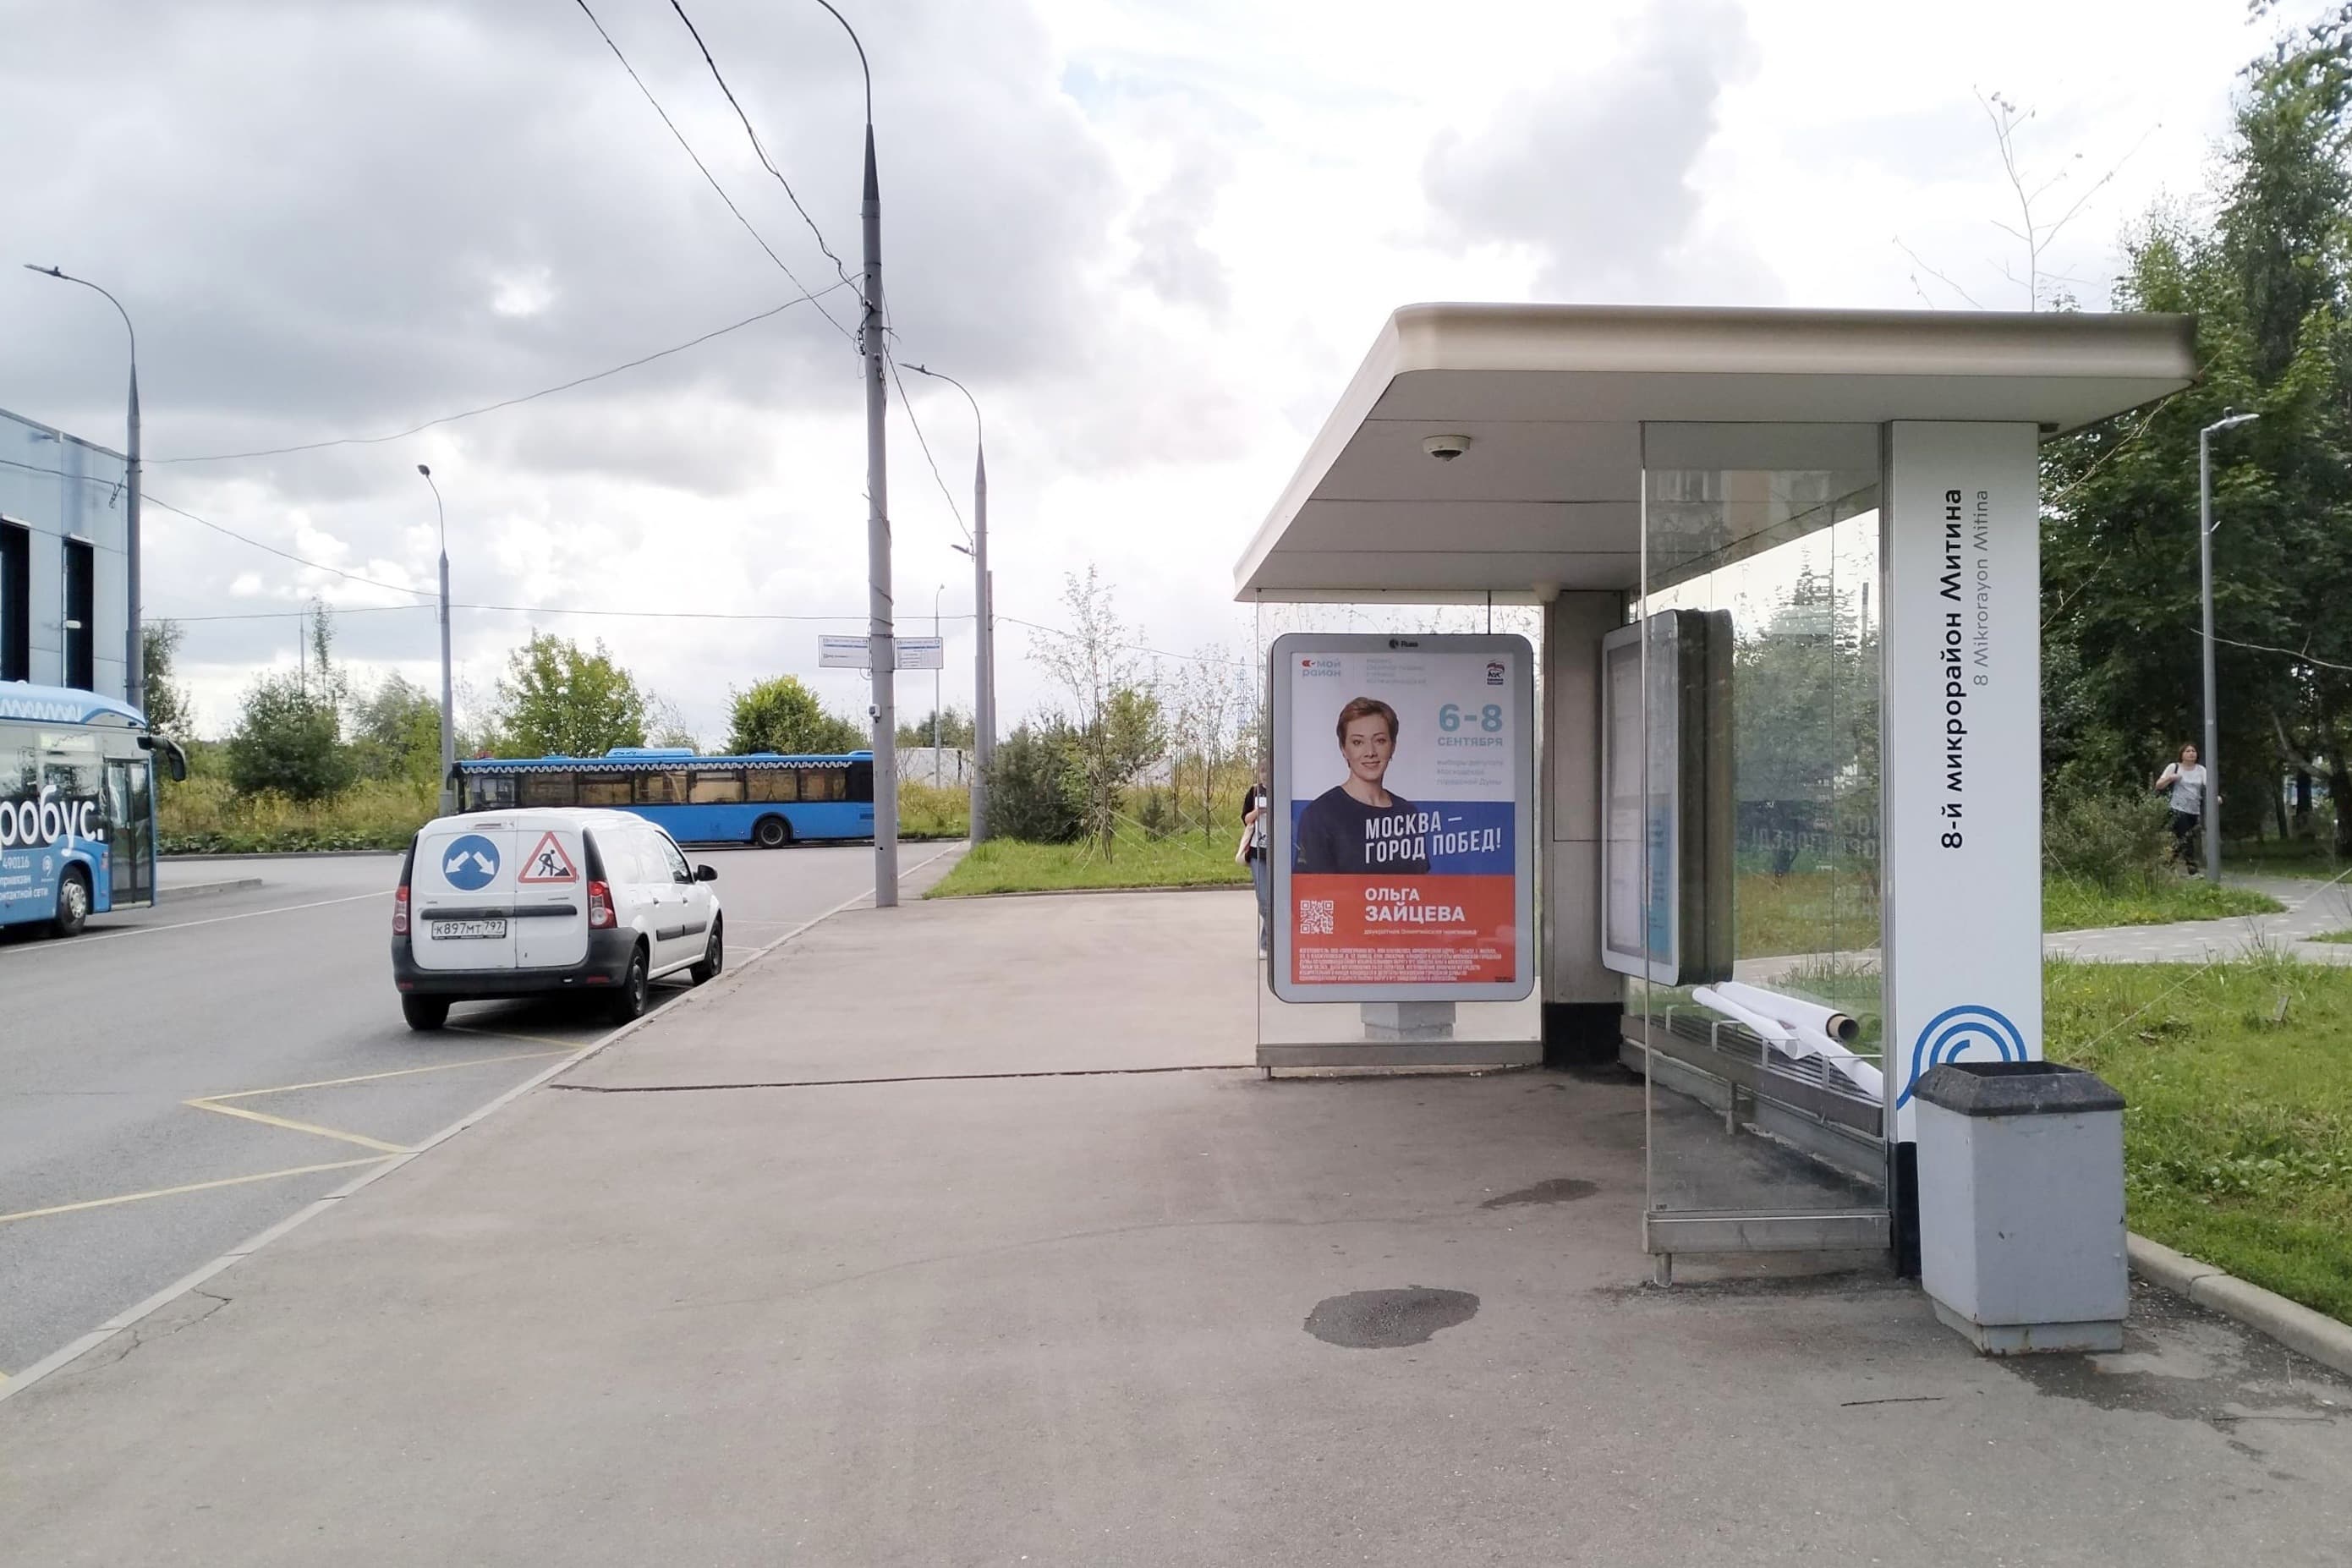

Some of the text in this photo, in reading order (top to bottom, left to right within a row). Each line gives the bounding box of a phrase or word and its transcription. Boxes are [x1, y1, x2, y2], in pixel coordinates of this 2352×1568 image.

[1973, 491, 1992, 686] 8 Mikrorayon Mitina
[1940, 489, 1968, 848] 8-й микрорайон Митина
[1437, 737, 1503, 747] СЕНТЯБРЯ
[1365, 810, 1441, 840] МОСКВА
[1365, 827, 1502, 863] ГОРОД ПОБЕД!
[1364, 887, 1420, 902] ОЛЬГА
[1364, 902, 1466, 924] ЗАЙЦЕВА
[436, 921, 502, 935] К897МТ 797
